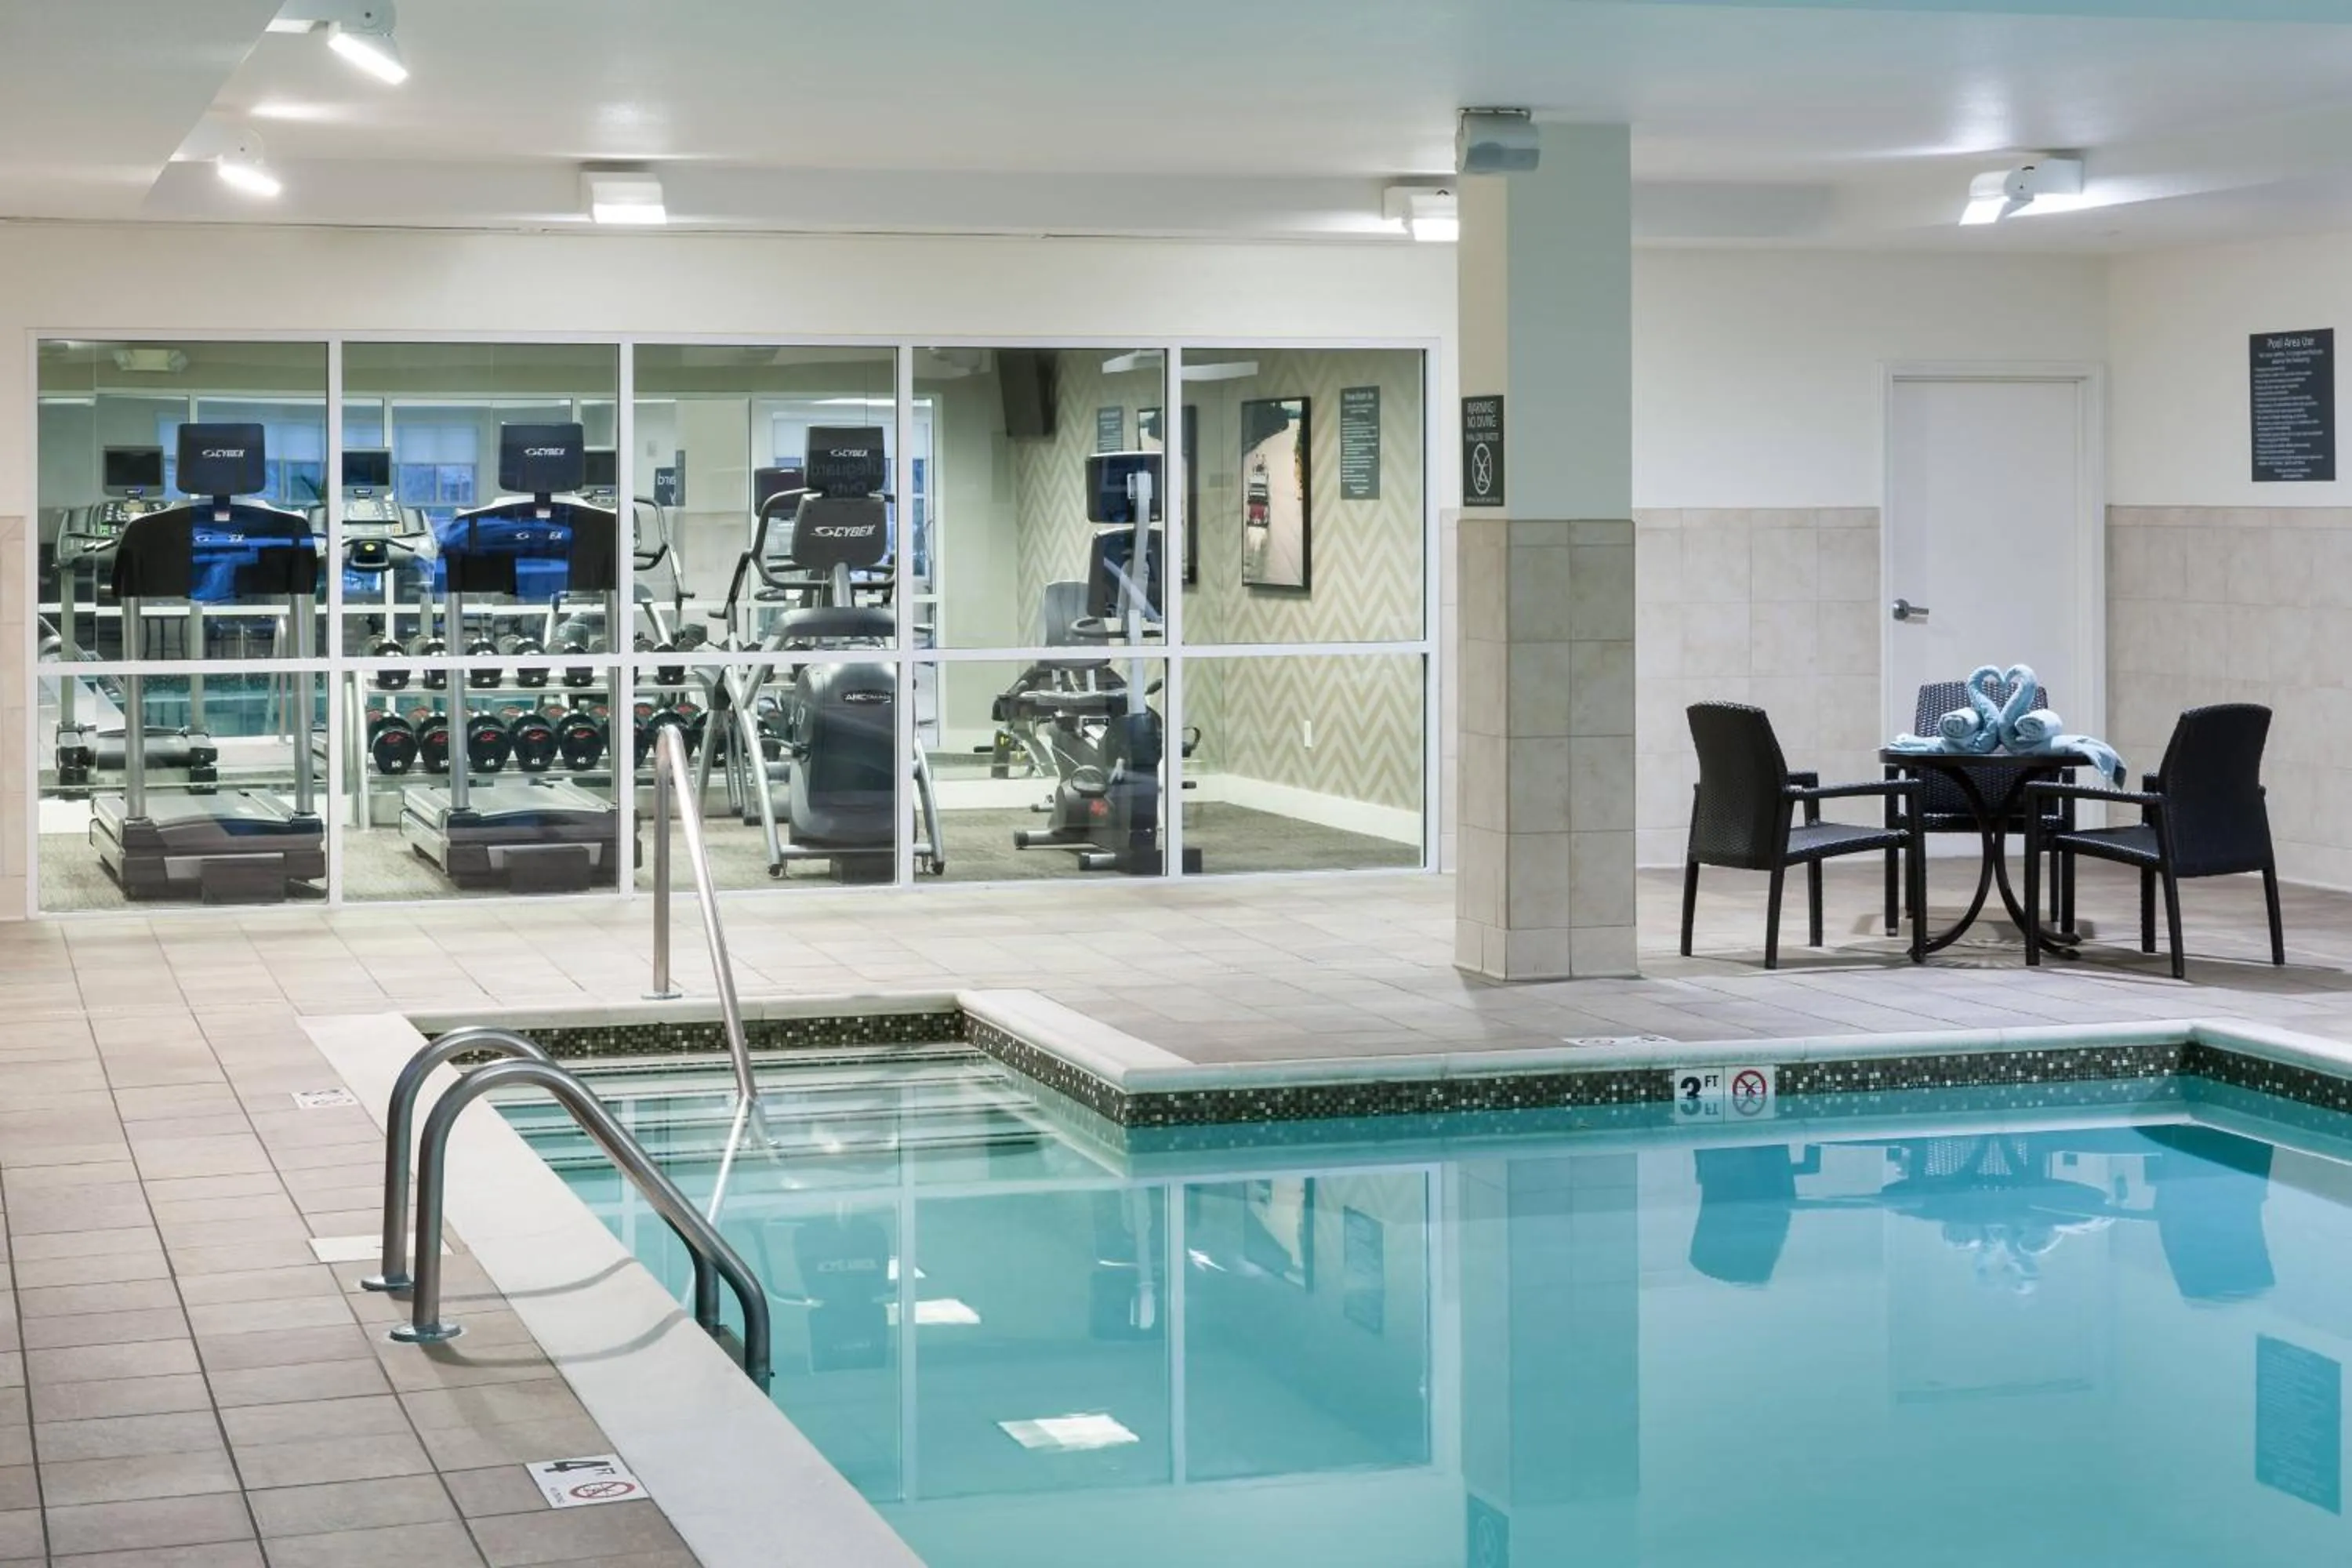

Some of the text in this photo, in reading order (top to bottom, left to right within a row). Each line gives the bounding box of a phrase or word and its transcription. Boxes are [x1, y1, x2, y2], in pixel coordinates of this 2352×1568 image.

[2267, 337, 2283, 349] Pool
[2285, 337, 2301, 347] Area
[833, 524, 876, 537] CYBEX
[1704, 1075, 1719, 1087] FT
